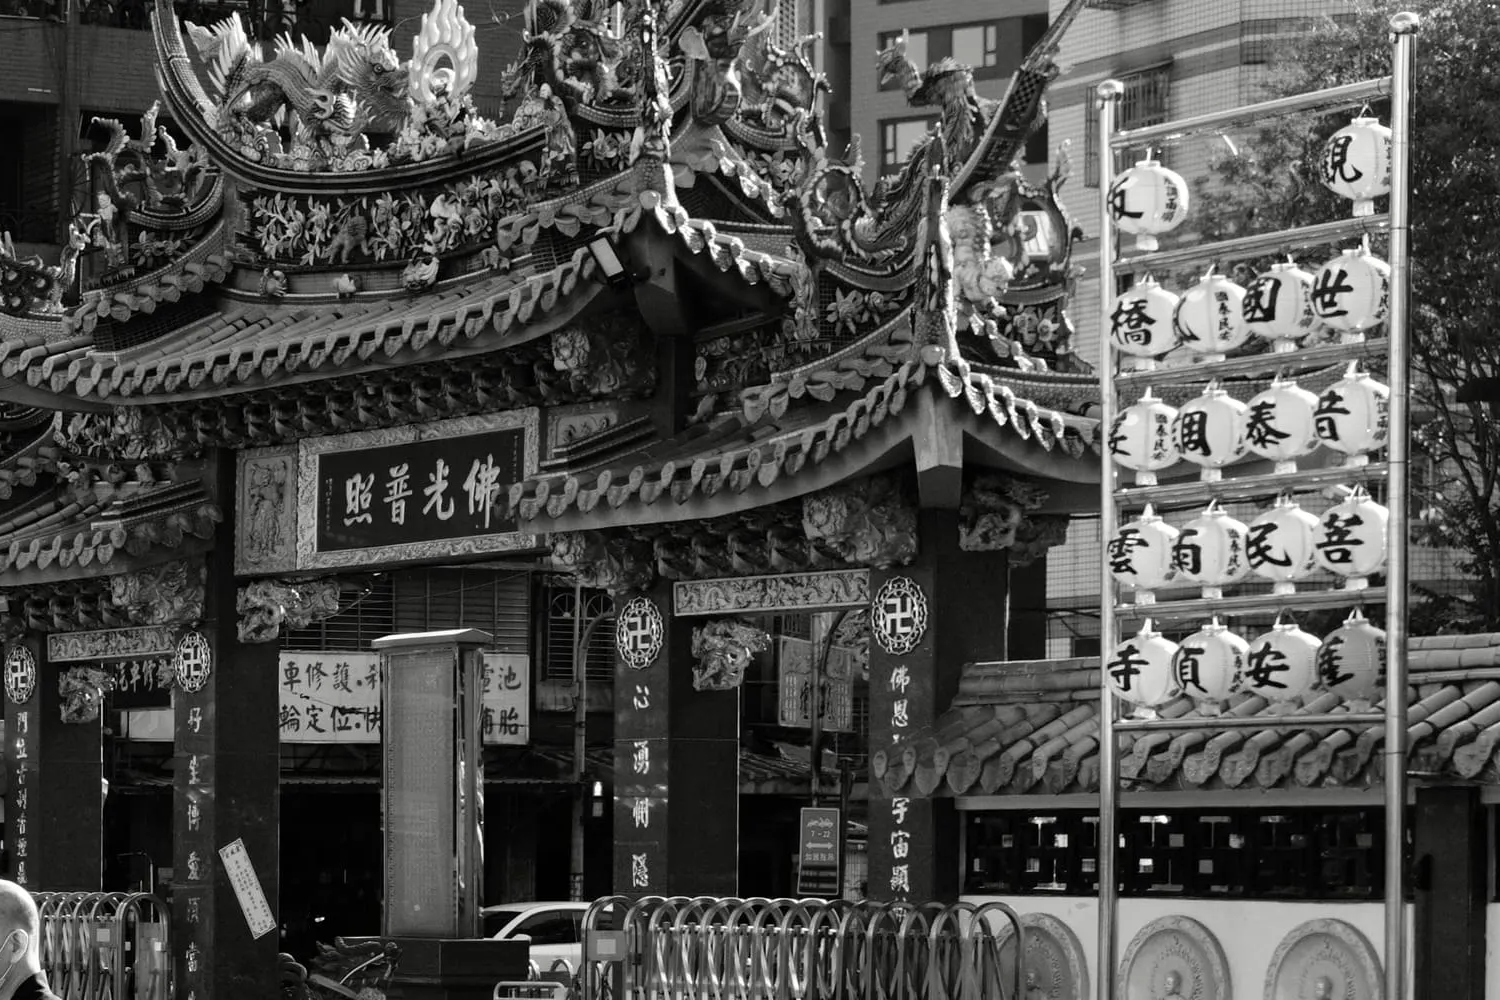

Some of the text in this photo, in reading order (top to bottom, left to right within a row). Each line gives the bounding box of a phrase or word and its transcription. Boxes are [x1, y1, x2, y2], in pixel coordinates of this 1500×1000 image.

[1311, 268, 1353, 318] 世
[1110, 298, 1155, 345] 橋
[1246, 401, 1291, 449] 泰
[1314, 390, 1351, 441] 音
[343, 453, 500, 529] 佛光普照
[1107, 529, 1149, 575] 雲
[1246, 523, 1292, 569] 民
[1316, 513, 1364, 563] 菩
[1107, 644, 1149, 691] 寺
[1246, 641, 1290, 689] 安
